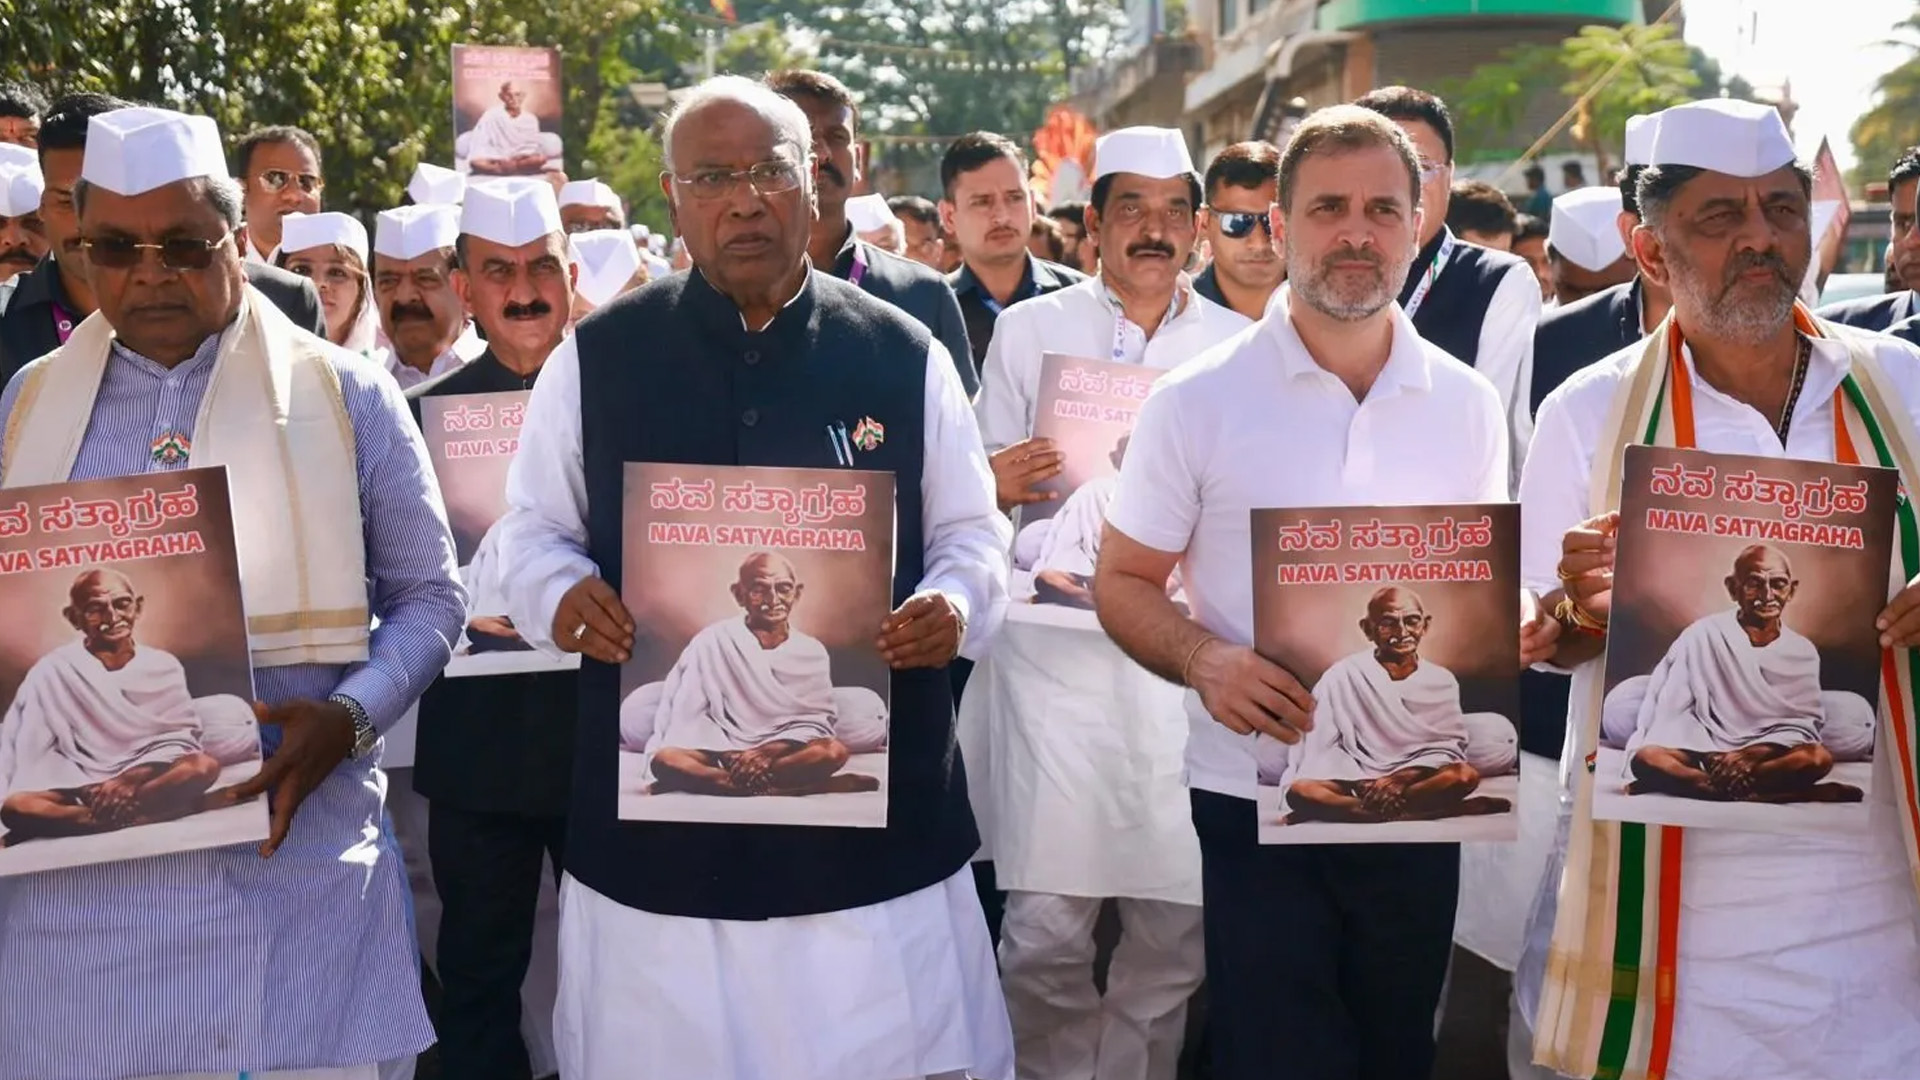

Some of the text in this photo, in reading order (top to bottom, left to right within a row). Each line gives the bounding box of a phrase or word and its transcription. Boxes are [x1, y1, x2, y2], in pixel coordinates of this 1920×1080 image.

[1059, 366, 1107, 395] ನವ
[444, 403, 493, 432] ನವ
[1054, 399, 1100, 422] NAVA
[445, 440, 494, 459] NAVA
[650, 477, 866, 526] ನವ ಸತ್ಯಾಗ್ರಹ
[1651, 463, 1868, 519] ನವ ಸತ್ಯಾಗ್ರಹ
[40, 484, 197, 537] ಸತ್ಯಾಗ್ರಹ
[649, 522, 865, 550] NAVA SATYAGRAHA
[1279, 515, 1492, 560] ನವ ಸತ್ಯಾಗ್ರಹ
[1647, 508, 1864, 549] NAVA SATYAGRAHA
[38, 531, 205, 569] SATYAGRAHA
[1278, 560, 1492, 584] NAVA SATYAGRAHA
